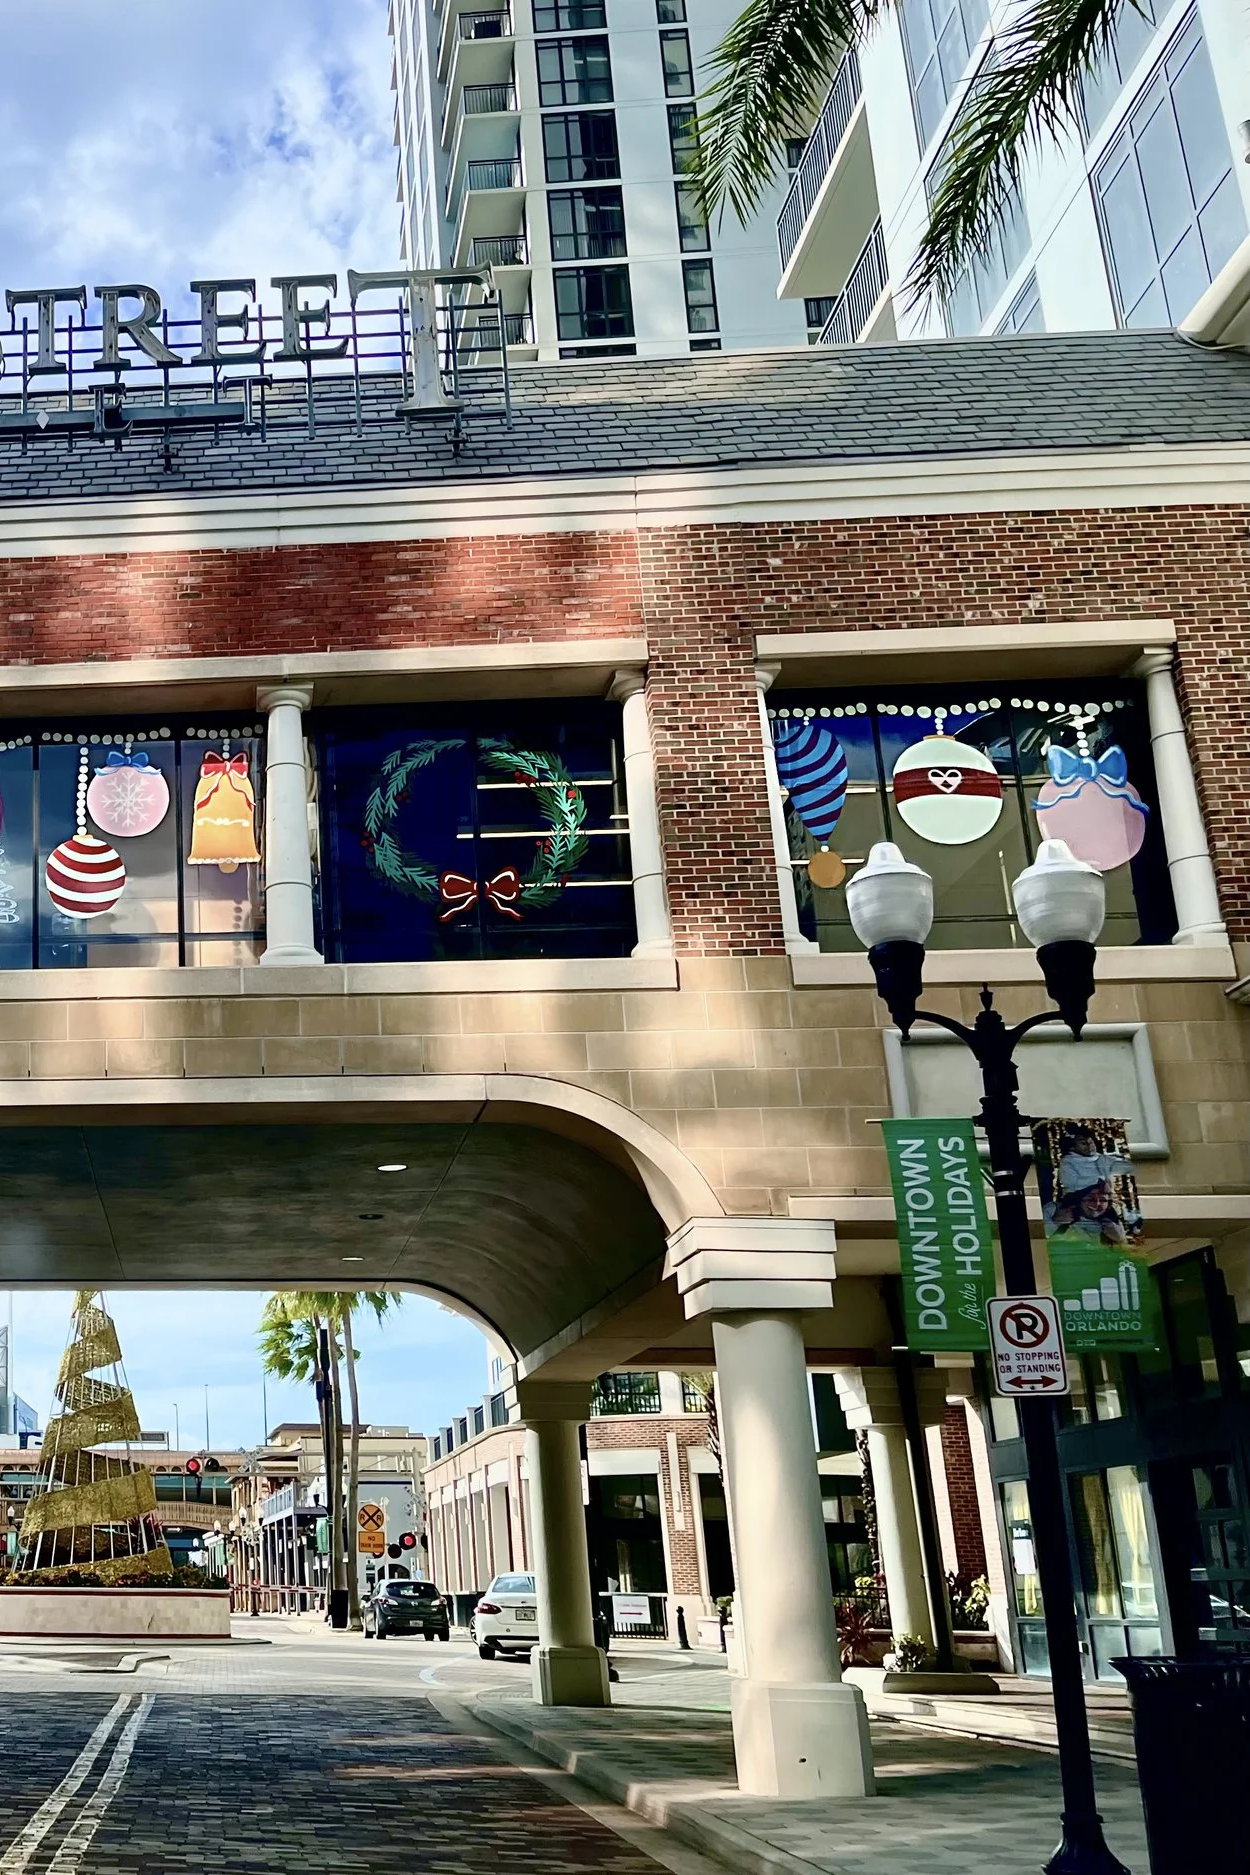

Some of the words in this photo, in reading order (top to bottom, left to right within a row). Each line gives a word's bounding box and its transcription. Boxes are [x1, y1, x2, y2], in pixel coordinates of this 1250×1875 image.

[938, 1136, 983, 1275] HOLIDAYS
[897, 1139, 948, 1331] DOWNTOWN
[957, 1282, 977, 1302] the
[957, 1302, 987, 1330] for
[1063, 1312, 1142, 1321] DOWNTOWN
[1065, 1321, 1142, 1332] ORLANDO
[997, 1353, 1010, 1362] NO
[1015, 1351, 1060, 1361] STOPPING
[999, 1365, 1012, 1374] OR
[1017, 1363, 1061, 1374] STANDING
